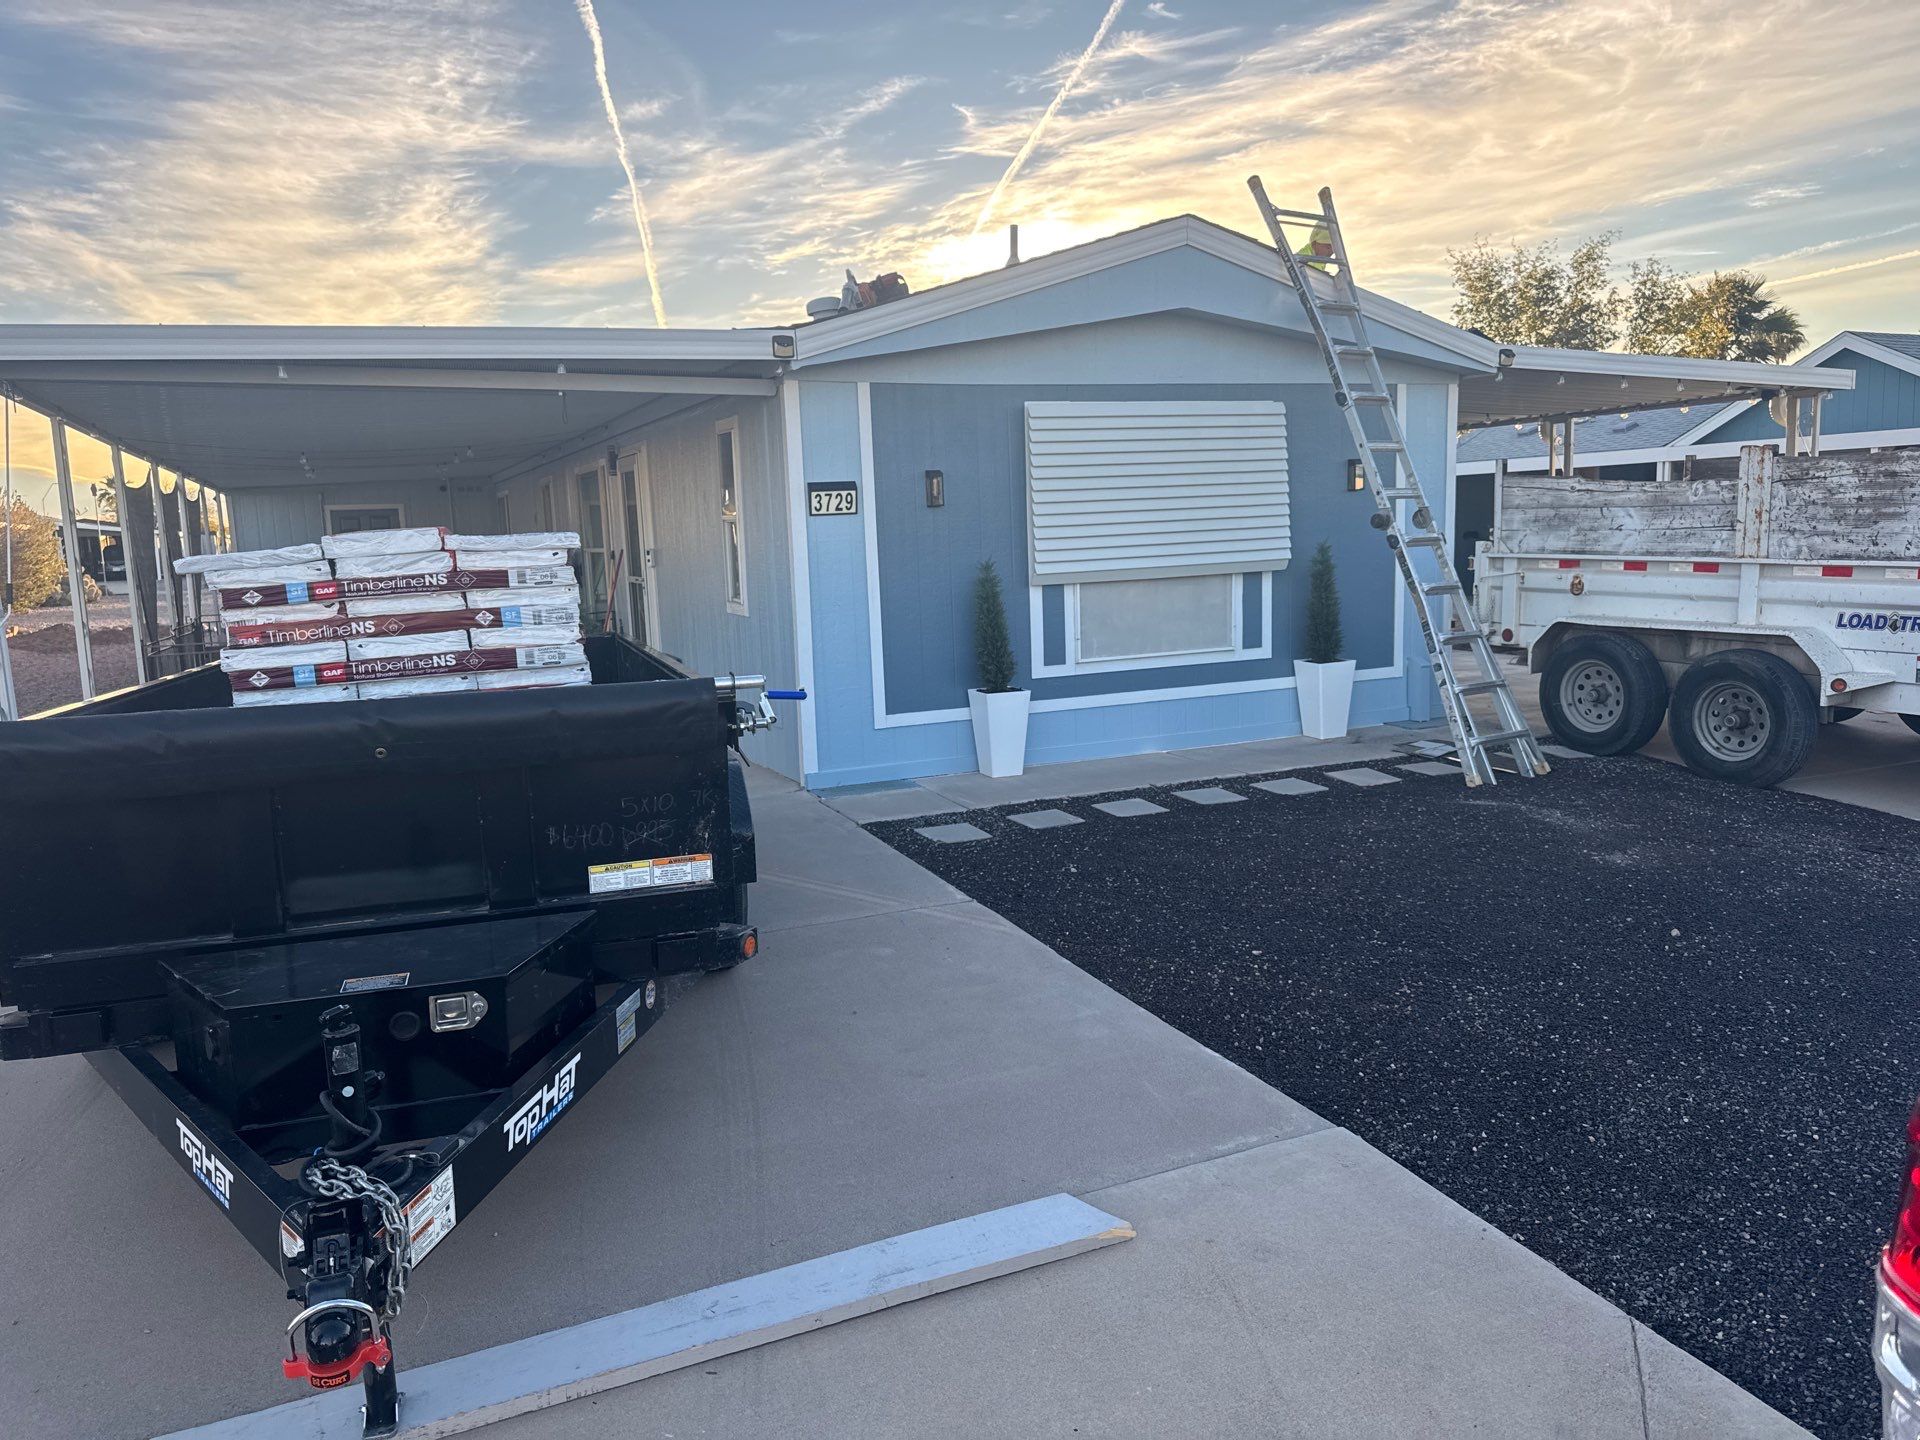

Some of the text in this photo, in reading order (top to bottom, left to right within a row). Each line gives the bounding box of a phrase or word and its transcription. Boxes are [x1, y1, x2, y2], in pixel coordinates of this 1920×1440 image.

[814, 492, 854, 512] 3729
[341, 573, 448, 592] TimberlineNS
[291, 587, 303, 595] SF
[315, 587, 336, 595] GAF
[505, 611, 518, 619] SF
[1836, 612, 1889, 631] LOAD
[266, 620, 376, 643] TimberlineNS
[349, 653, 457, 674] TimberlineNS
[323, 668, 344, 676] GAF
[609, 863, 633, 871] CAUTION
[530, 1089, 574, 1139] TRAILERS
[321, 1374, 348, 1387] CURT
